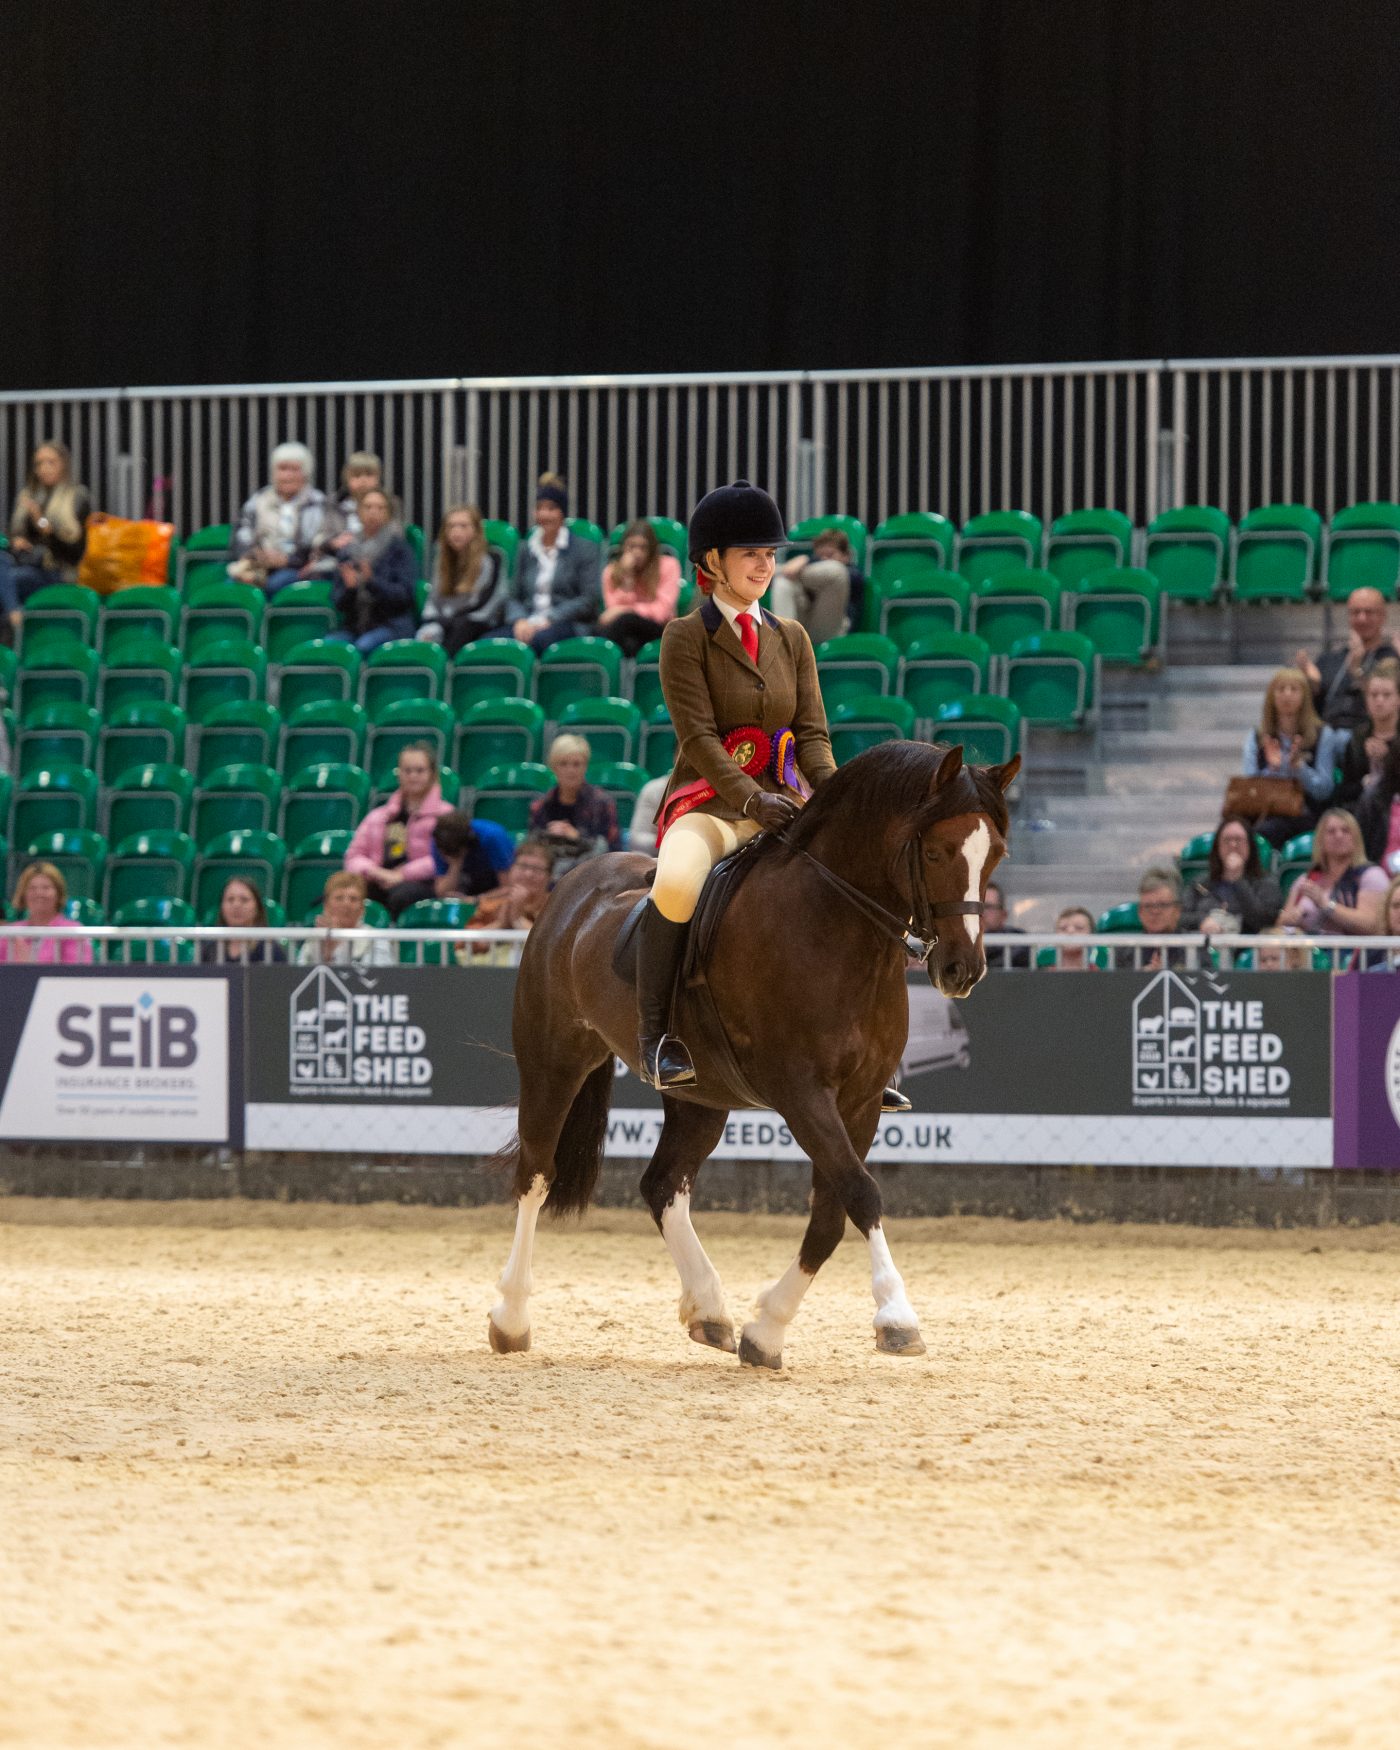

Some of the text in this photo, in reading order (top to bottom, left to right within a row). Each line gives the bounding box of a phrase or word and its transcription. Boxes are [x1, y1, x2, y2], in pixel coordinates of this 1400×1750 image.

[353, 995, 408, 1022] THE
[1202, 1001, 1263, 1029] THE
[354, 1026, 426, 1053] FEED
[1203, 1034, 1283, 1061] FEED
[56, 1076, 130, 1089] INSURANCE
[352, 1057, 433, 1084] SHED
[1203, 1066, 1291, 1094] SHED
